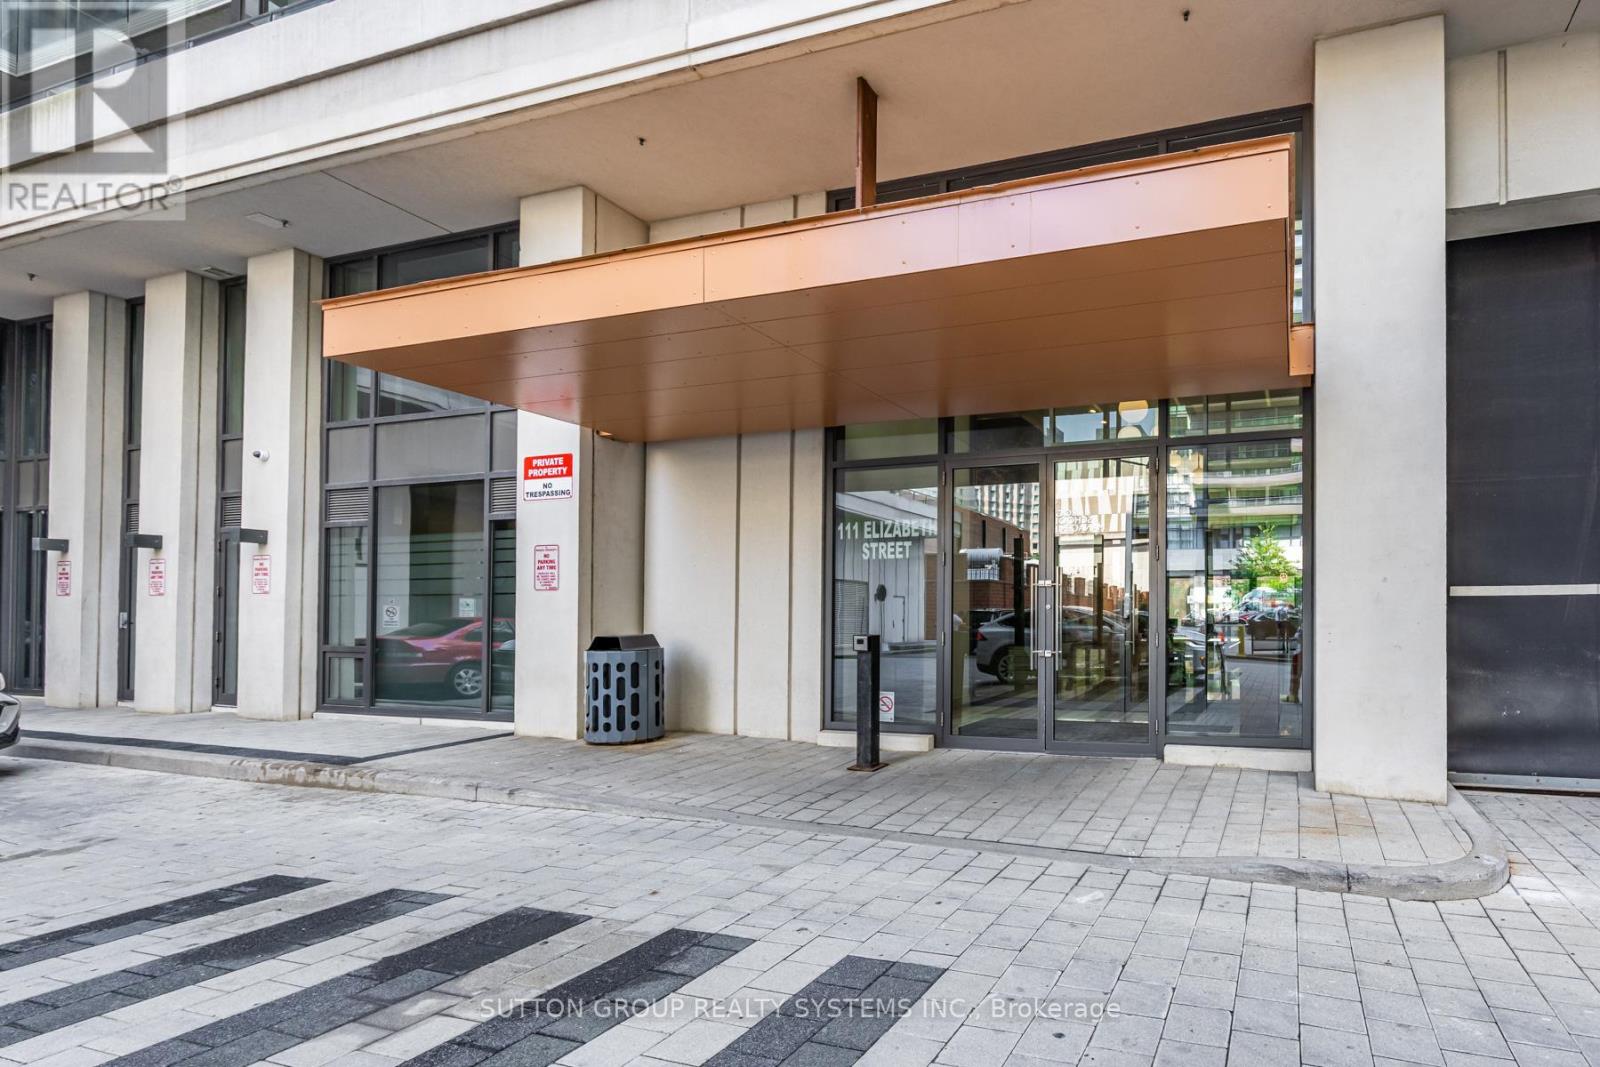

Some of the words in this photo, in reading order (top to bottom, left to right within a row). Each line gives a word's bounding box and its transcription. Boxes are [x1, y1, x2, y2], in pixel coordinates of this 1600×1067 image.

[532, 457, 564, 467] PRIVATE
[528, 466, 568, 477] PROPERTY
[525, 489, 571, 498] TRESPASSING
[837, 521, 859, 540] 111
[862, 541, 912, 560] STREET
